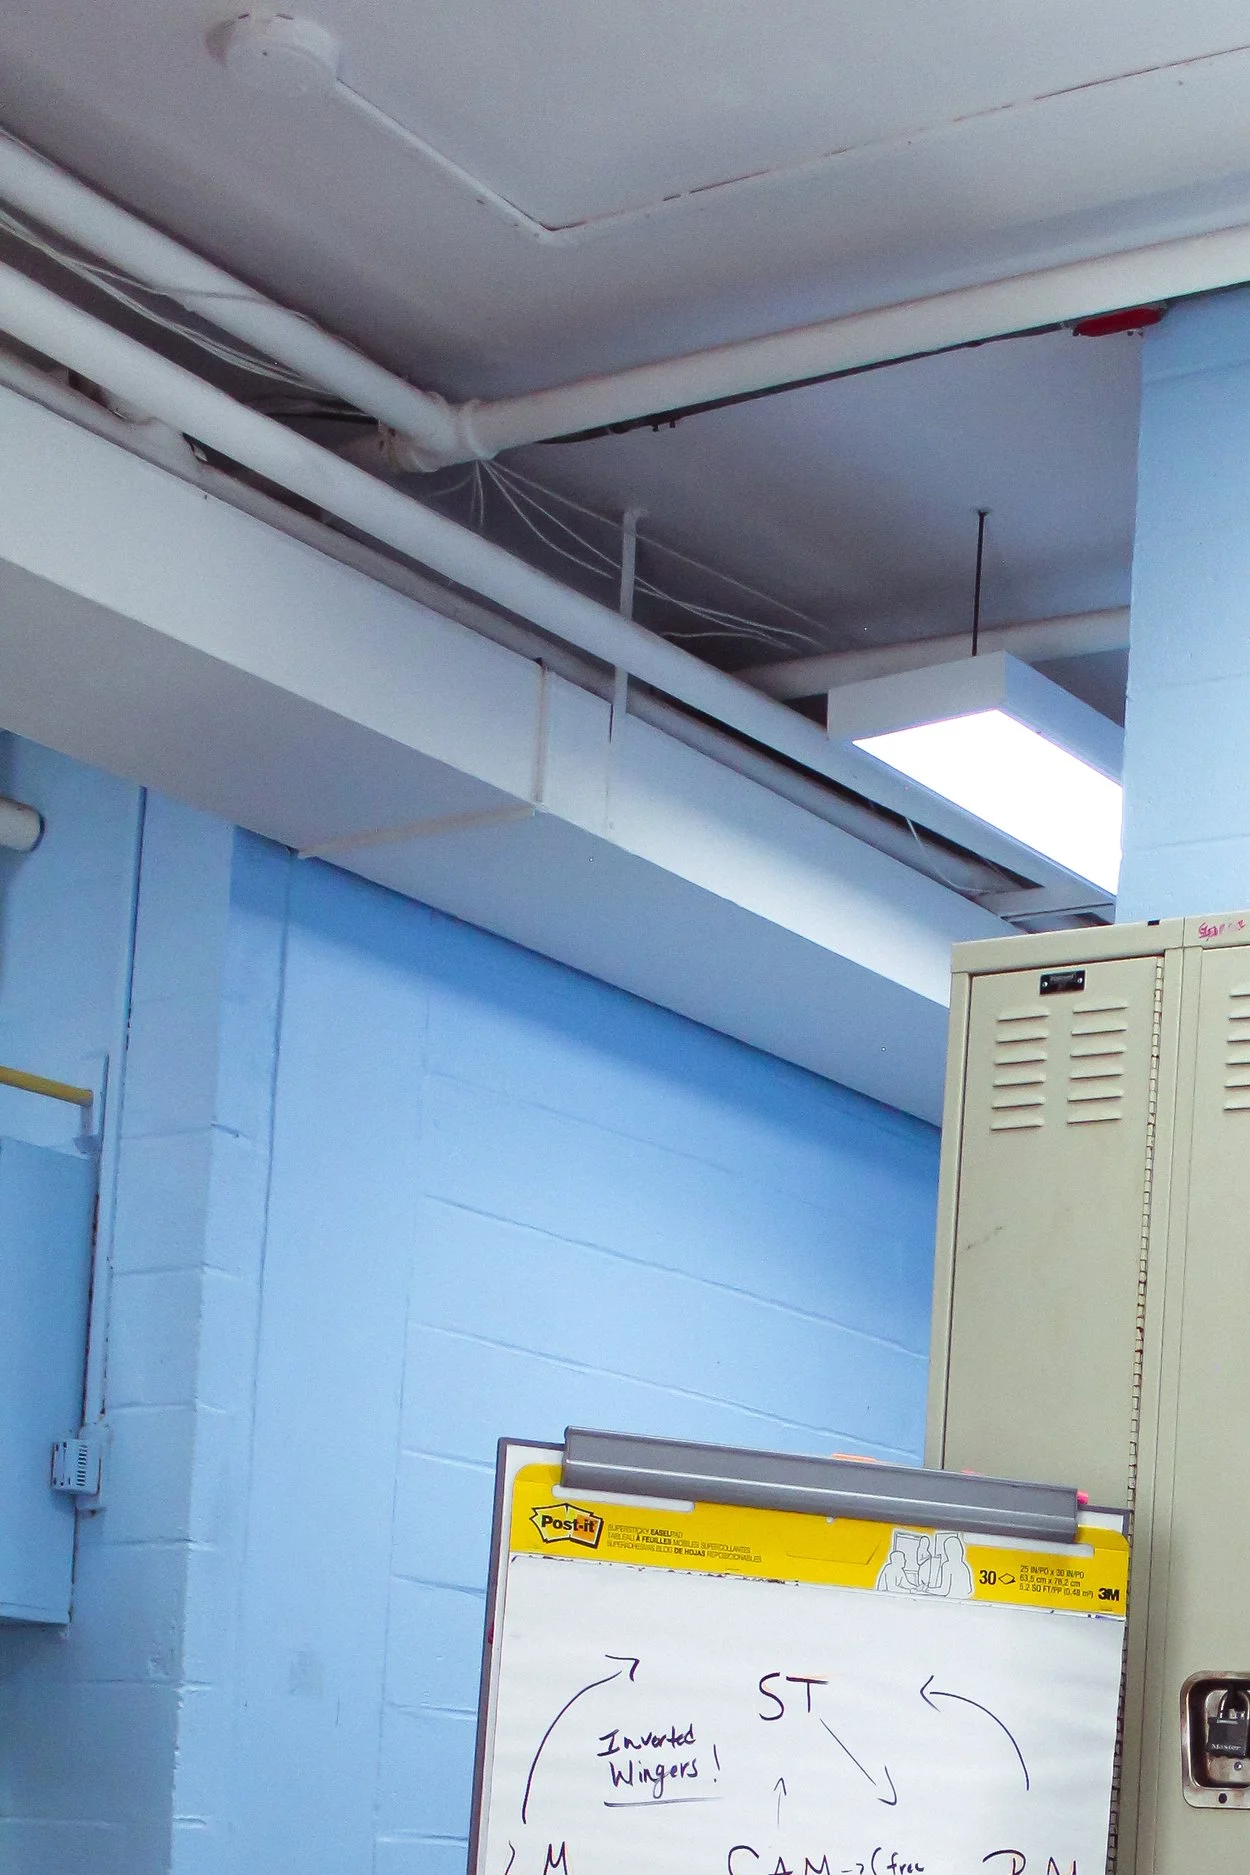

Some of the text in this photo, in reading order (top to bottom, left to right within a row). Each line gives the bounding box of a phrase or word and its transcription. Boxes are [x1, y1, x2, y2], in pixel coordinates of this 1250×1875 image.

[541, 1514, 596, 1533] Post-it
[684, 1548, 706, 1557] HOJAS
[979, 1570, 997, 1585] 30
[1098, 1587, 1120, 1601] 3M
[759, 1674, 829, 1720] ST
[597, 1723, 696, 1757] Inverted
